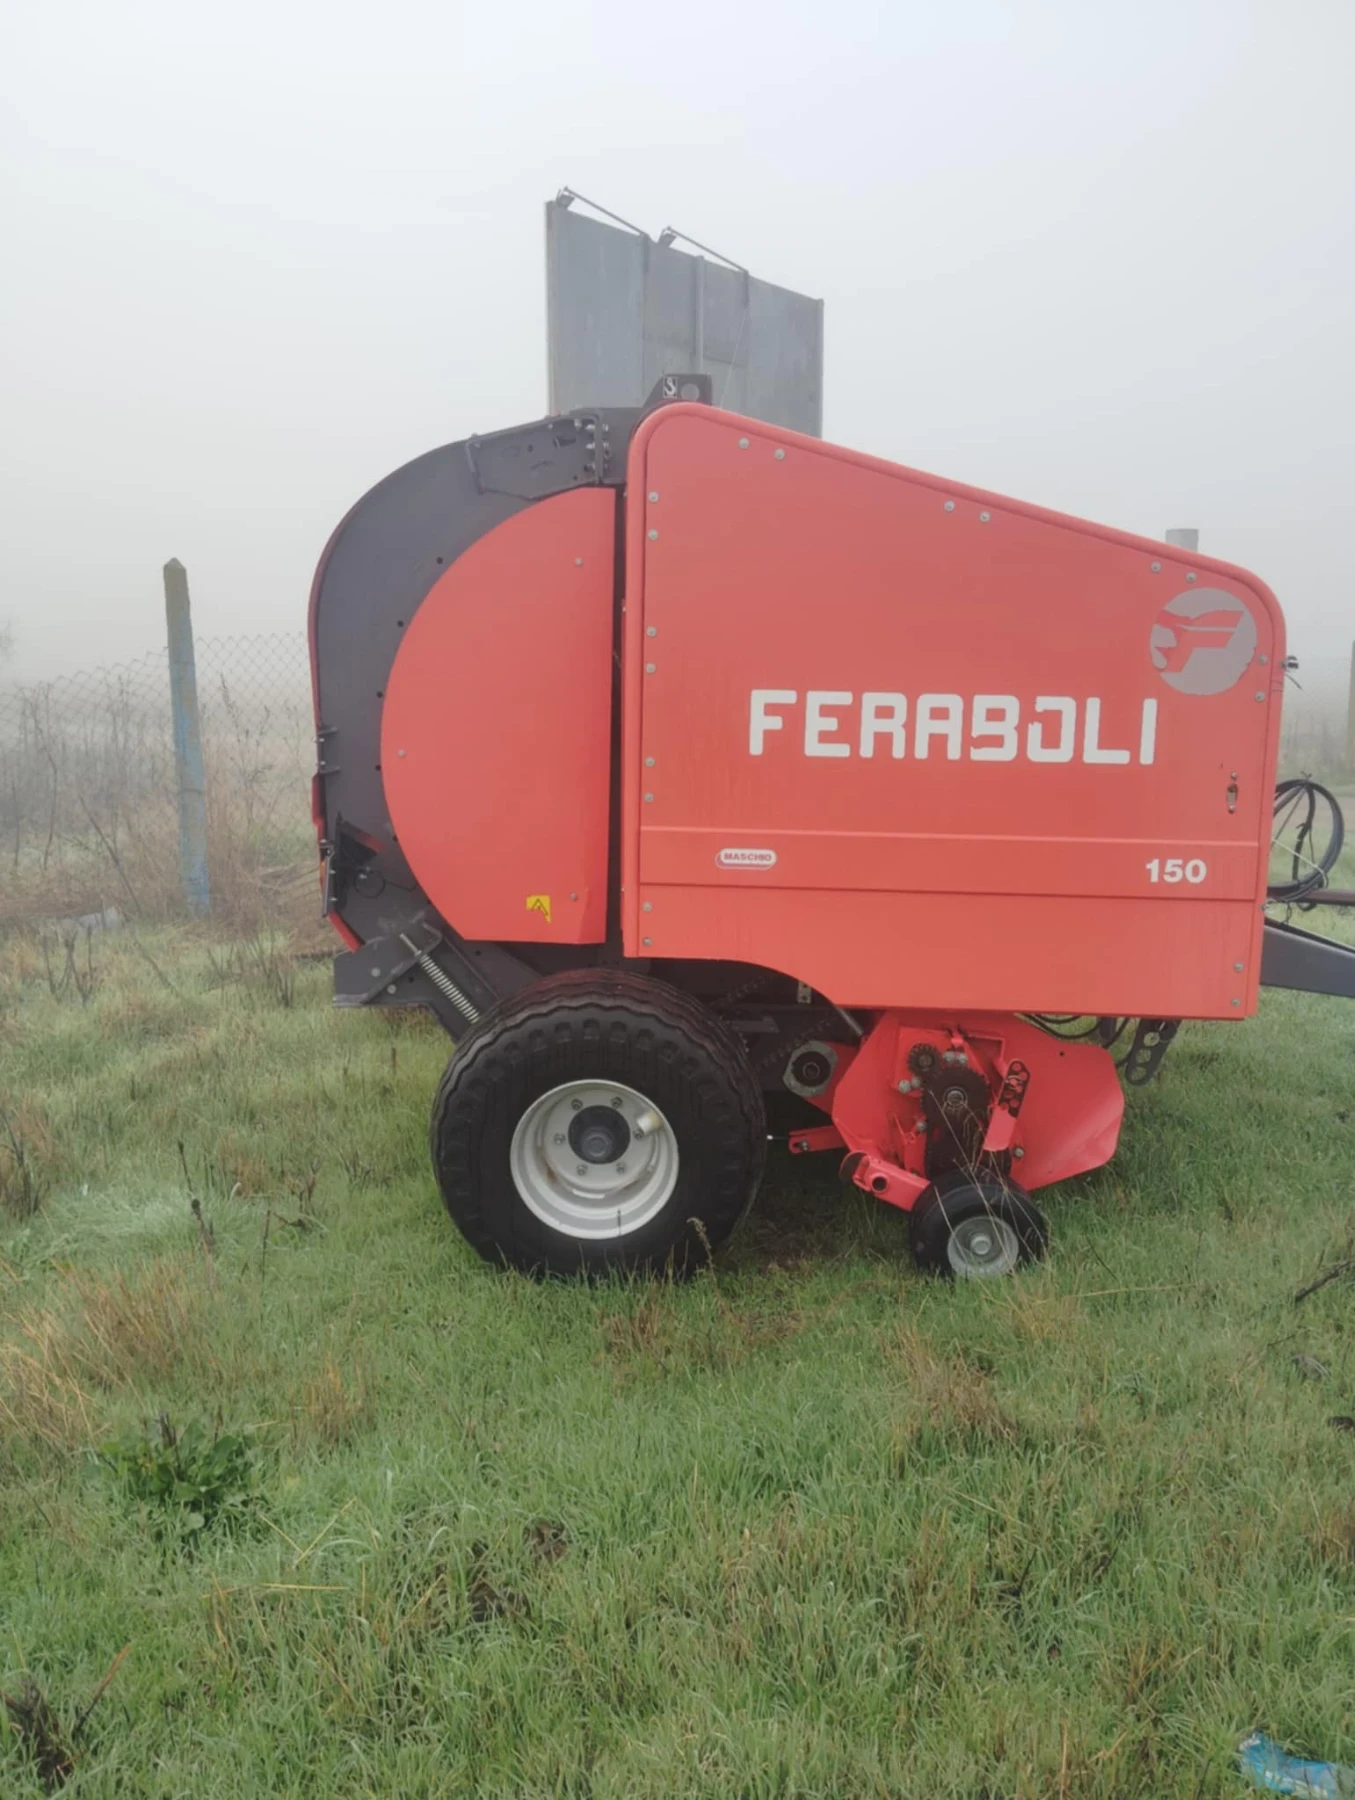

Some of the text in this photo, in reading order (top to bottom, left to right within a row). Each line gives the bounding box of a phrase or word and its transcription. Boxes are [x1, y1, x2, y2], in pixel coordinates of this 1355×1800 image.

[749, 689, 1158, 765] FERABOLI
[723, 851, 773, 863] MASCHIO
[1145, 858, 1207, 884] 150
